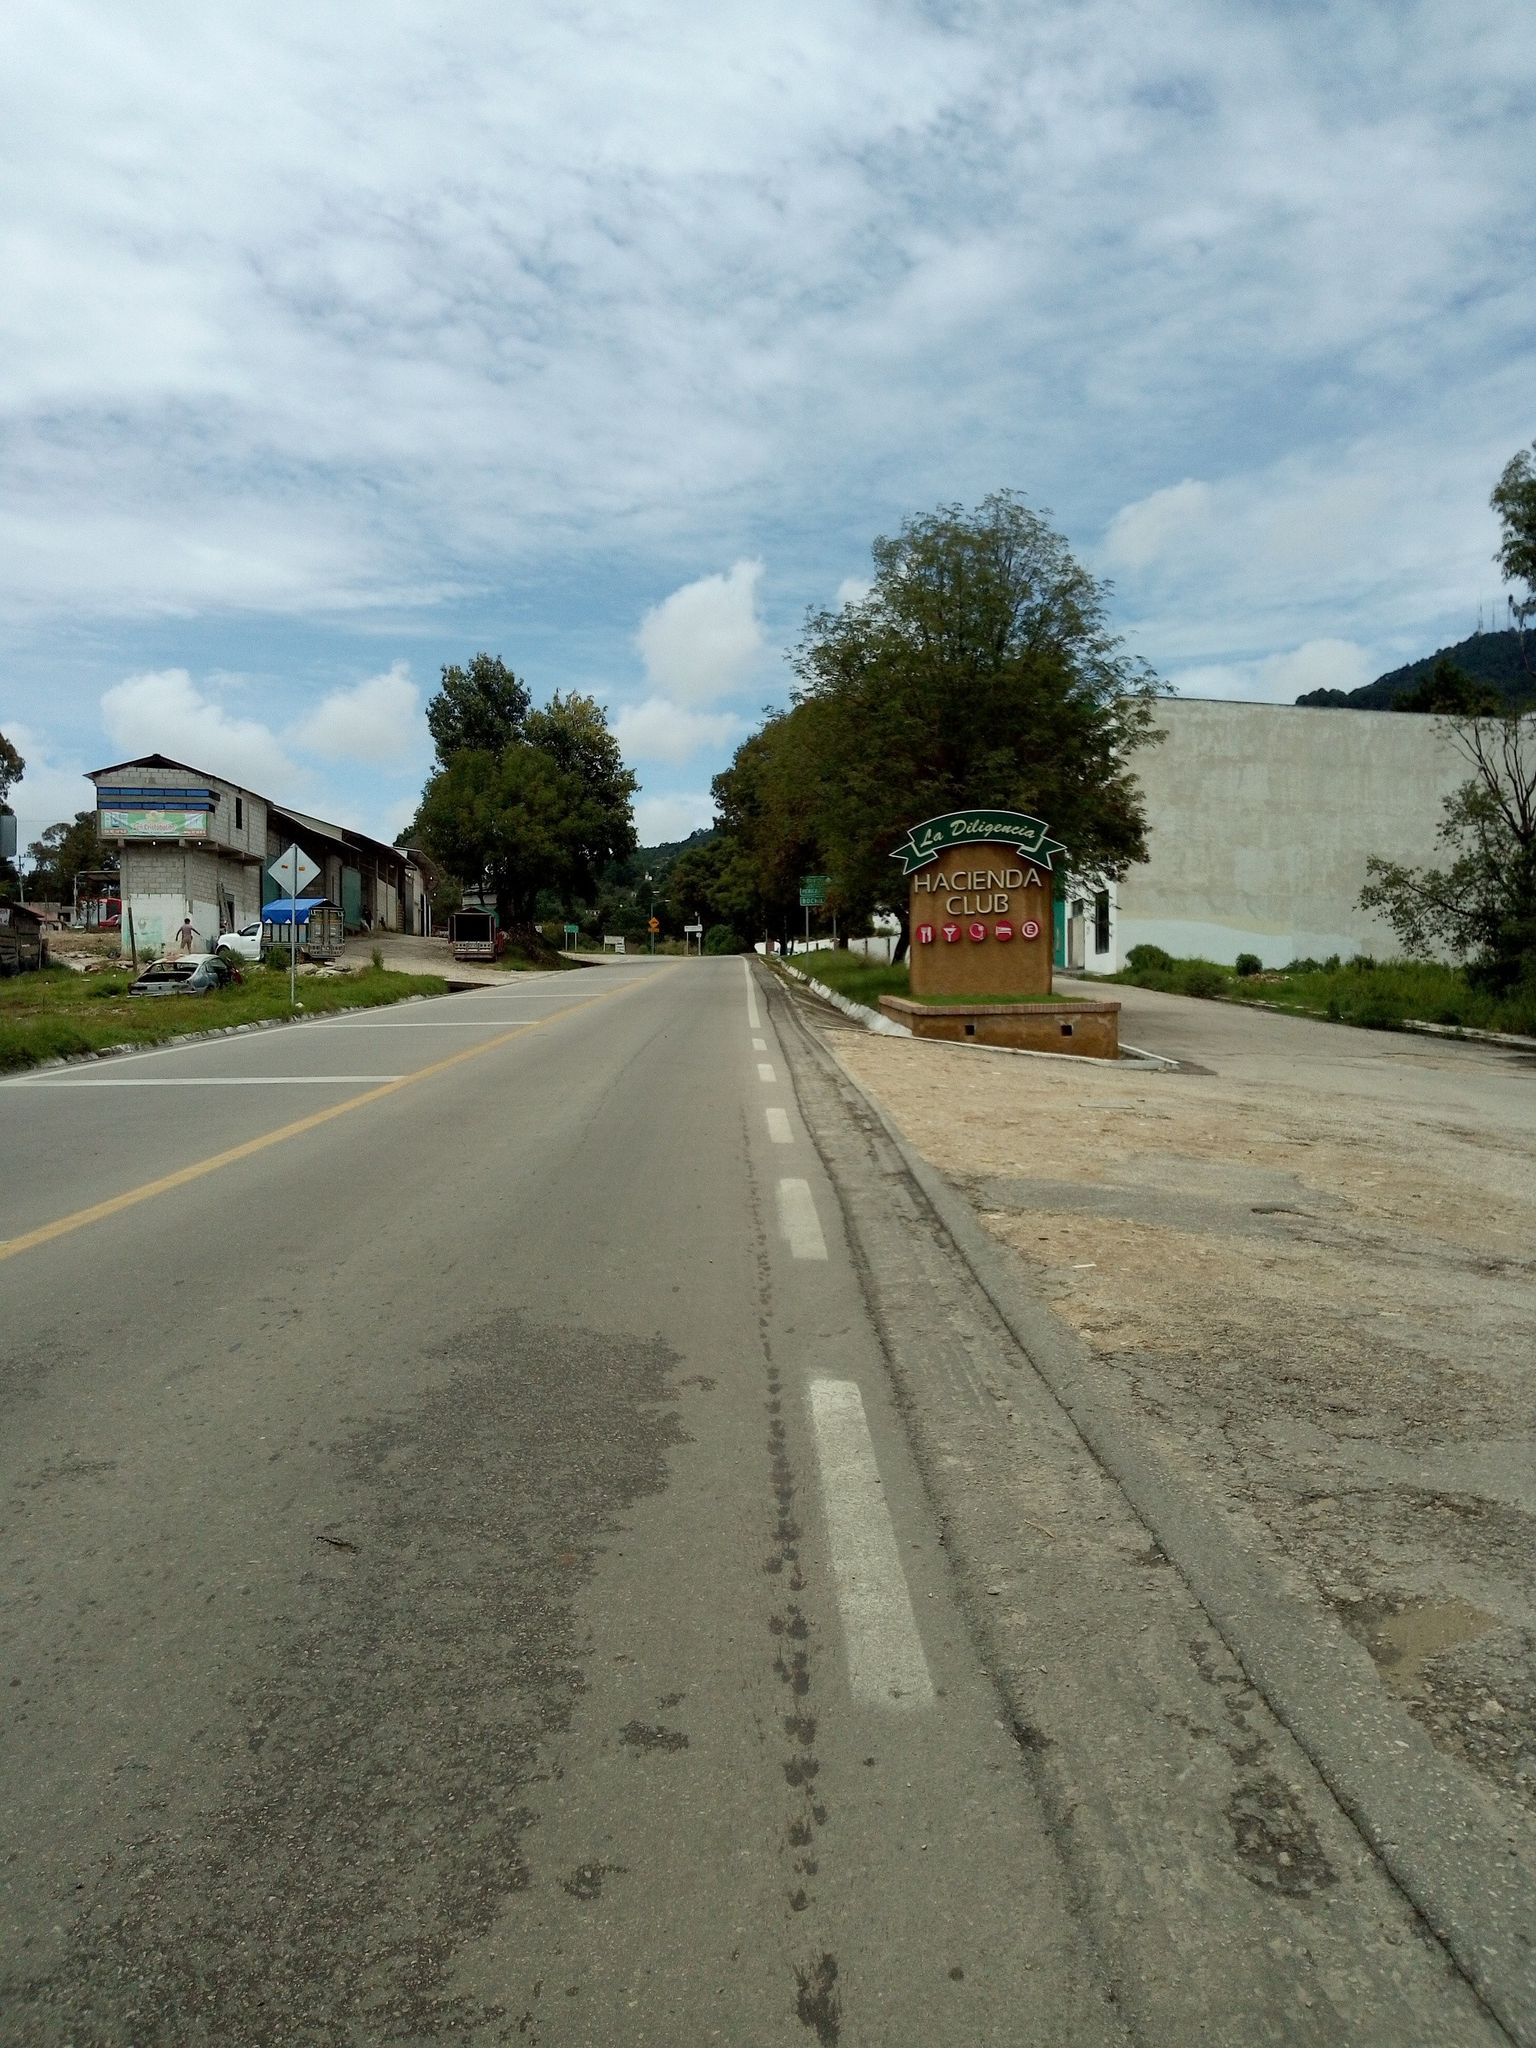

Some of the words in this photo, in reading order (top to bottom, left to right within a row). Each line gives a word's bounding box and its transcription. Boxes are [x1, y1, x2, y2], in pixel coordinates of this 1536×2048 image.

[920, 828, 945, 848] La
[950, 818, 1036, 840] Diligencia
[914, 867, 1043, 893] HACIENDA
[946, 893, 1010, 915] CLUB
